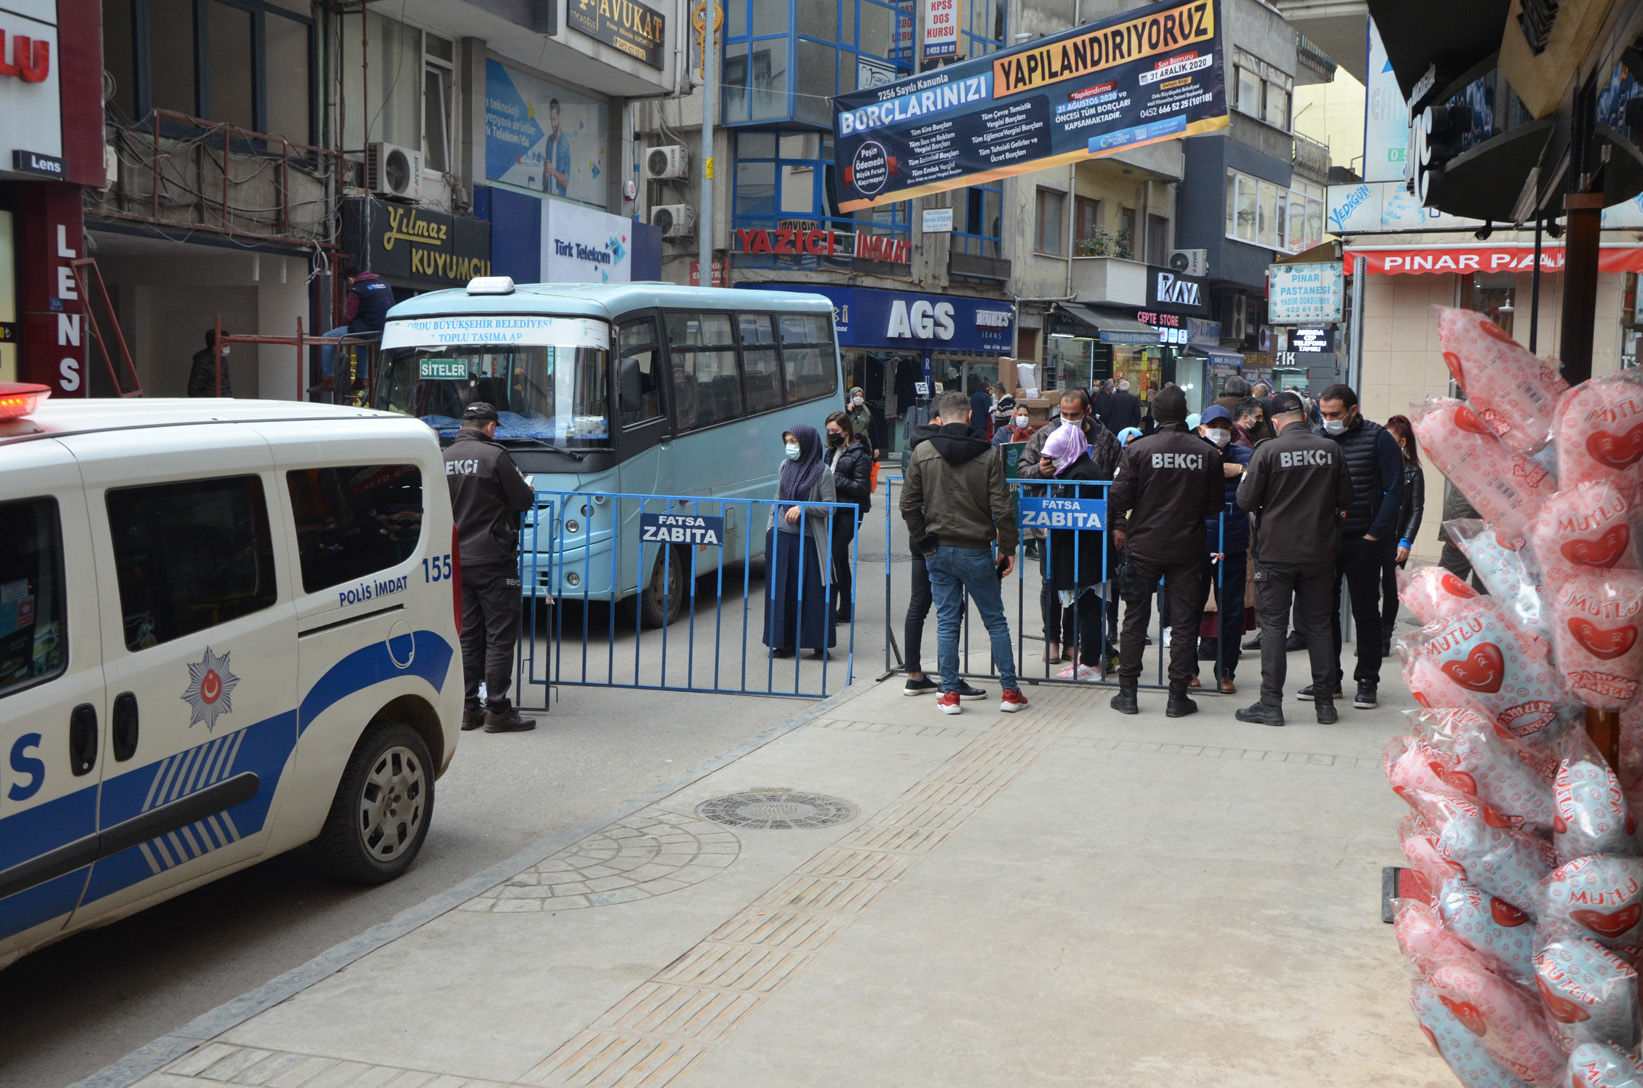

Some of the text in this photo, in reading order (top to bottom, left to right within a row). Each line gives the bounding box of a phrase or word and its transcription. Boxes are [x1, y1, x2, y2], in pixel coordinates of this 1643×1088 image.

[931, 0, 953, 11] KPSS
[600, 0, 663, 43] AVUKAT
[933, 13, 950, 25] DGS
[926, 26, 955, 38] KURSU
[1000, 3, 1208, 91] YAPILANDIRIYORUZ
[1149, 59, 1207, 81] 31 ARALIK 2020
[1158, 60, 1169, 68] Son
[878, 74, 949, 101] 7256 Sayılı Kanunla
[841, 75, 987, 135] BORÇLARINIZI
[981, 102, 1032, 120] Tüm Çevre Temizlik
[1055, 98, 1131, 124] ÖNCESİ TÜM BORÇLARI
[1057, 90, 1128, 113] 31 AĞUSTOS 2020 ve
[1140, 107, 1157, 118] 0452
[1158, 104, 1171, 114] 666
[1171, 101, 1180, 111] 52
[1180, 99, 1189, 109] 25
[910, 121, 953, 136] Tüm Kira Borçları
[971, 135, 983, 144] Tüm
[1021, 121, 1043, 133] Borçları
[909, 139, 920, 148] Tüm
[978, 148, 990, 157] Tüm
[31, 154, 62, 173] Lens
[908, 157, 919, 166] Tüm
[1005, 149, 1027, 161] Borçları
[911, 168, 923, 177] Tüm
[1328, 184, 1371, 231] YEDİGÜN
[384, 206, 447, 250] Yılmaz
[554, 238, 611, 265] Türk Telekom
[737, 228, 835, 256] YAZICI
[412, 248, 491, 280] KUYUMCU
[1384, 254, 1481, 270] PINAR
[1291, 273, 1320, 283] PINAR
[1280, 284, 1331, 296] PASTANESİ
[433, 317, 493, 331] BÜYÜKŞEHİR
[887, 300, 955, 341] AGS
[1137, 311, 1179, 327] CEPTE STORE
[438, 332, 506, 343] TOPLU TAŞIMA
[981, 331, 1002, 339] JEANS
[420, 360, 466, 377] SİTELER
[1042, 499, 1081, 511] FATSA
[658, 514, 706, 527] FATSA
[1021, 510, 1103, 529] ZABITA
[1556, 495, 1627, 536] MUTLU
[641, 525, 719, 545] ZABITA
[422, 554, 453, 584] 155
[338, 574, 408, 607] POLİS İMDAT
[1567, 594, 1640, 619] MUTLU
[1424, 617, 1484, 659] MUTLU
[8, 732, 46, 802] S
[1567, 875, 1640, 907] MUTLU
[1532, 953, 1598, 1006] MUTLU
